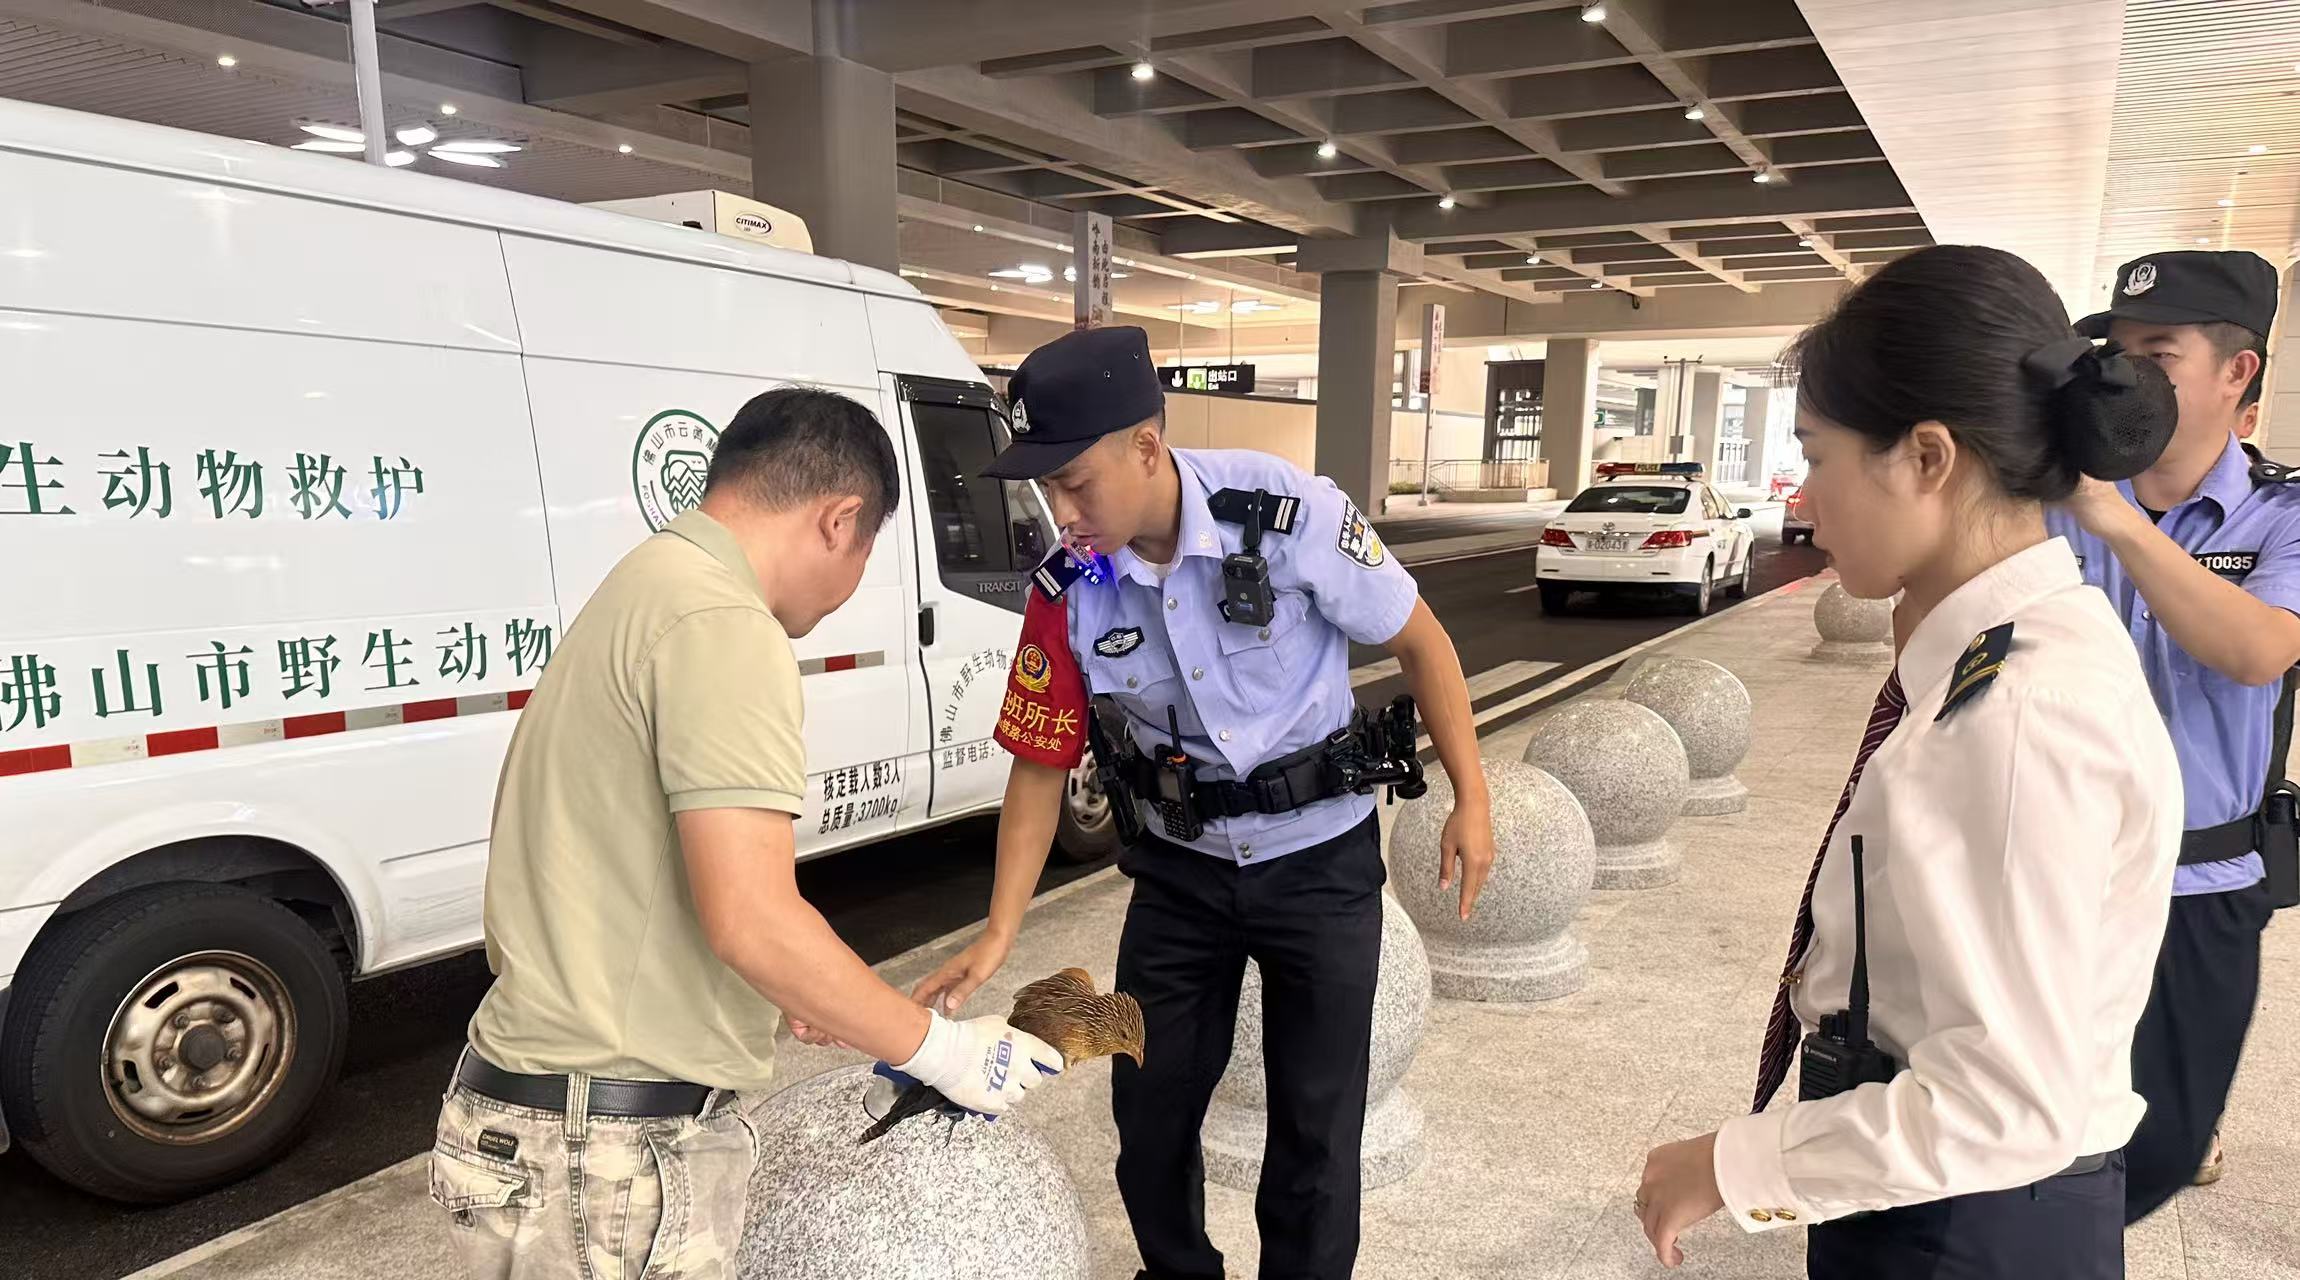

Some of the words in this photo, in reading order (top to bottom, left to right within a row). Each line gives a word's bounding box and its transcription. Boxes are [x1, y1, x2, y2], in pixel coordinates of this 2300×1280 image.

[736, 217, 767, 229] CITIMAX
[1208, 369, 1237, 382] 出站口
[0, 441, 424, 520] 生动物救护
[2197, 555, 2253, 570] T0035
[977, 582, 1021, 593] TRANSIT
[0, 618, 552, 732] 佛山市野生动物
[940, 648, 1012, 743] 佛山市野生动物
[1002, 689, 1078, 735] 班所长
[823, 757, 900, 802] 核定载人数3人
